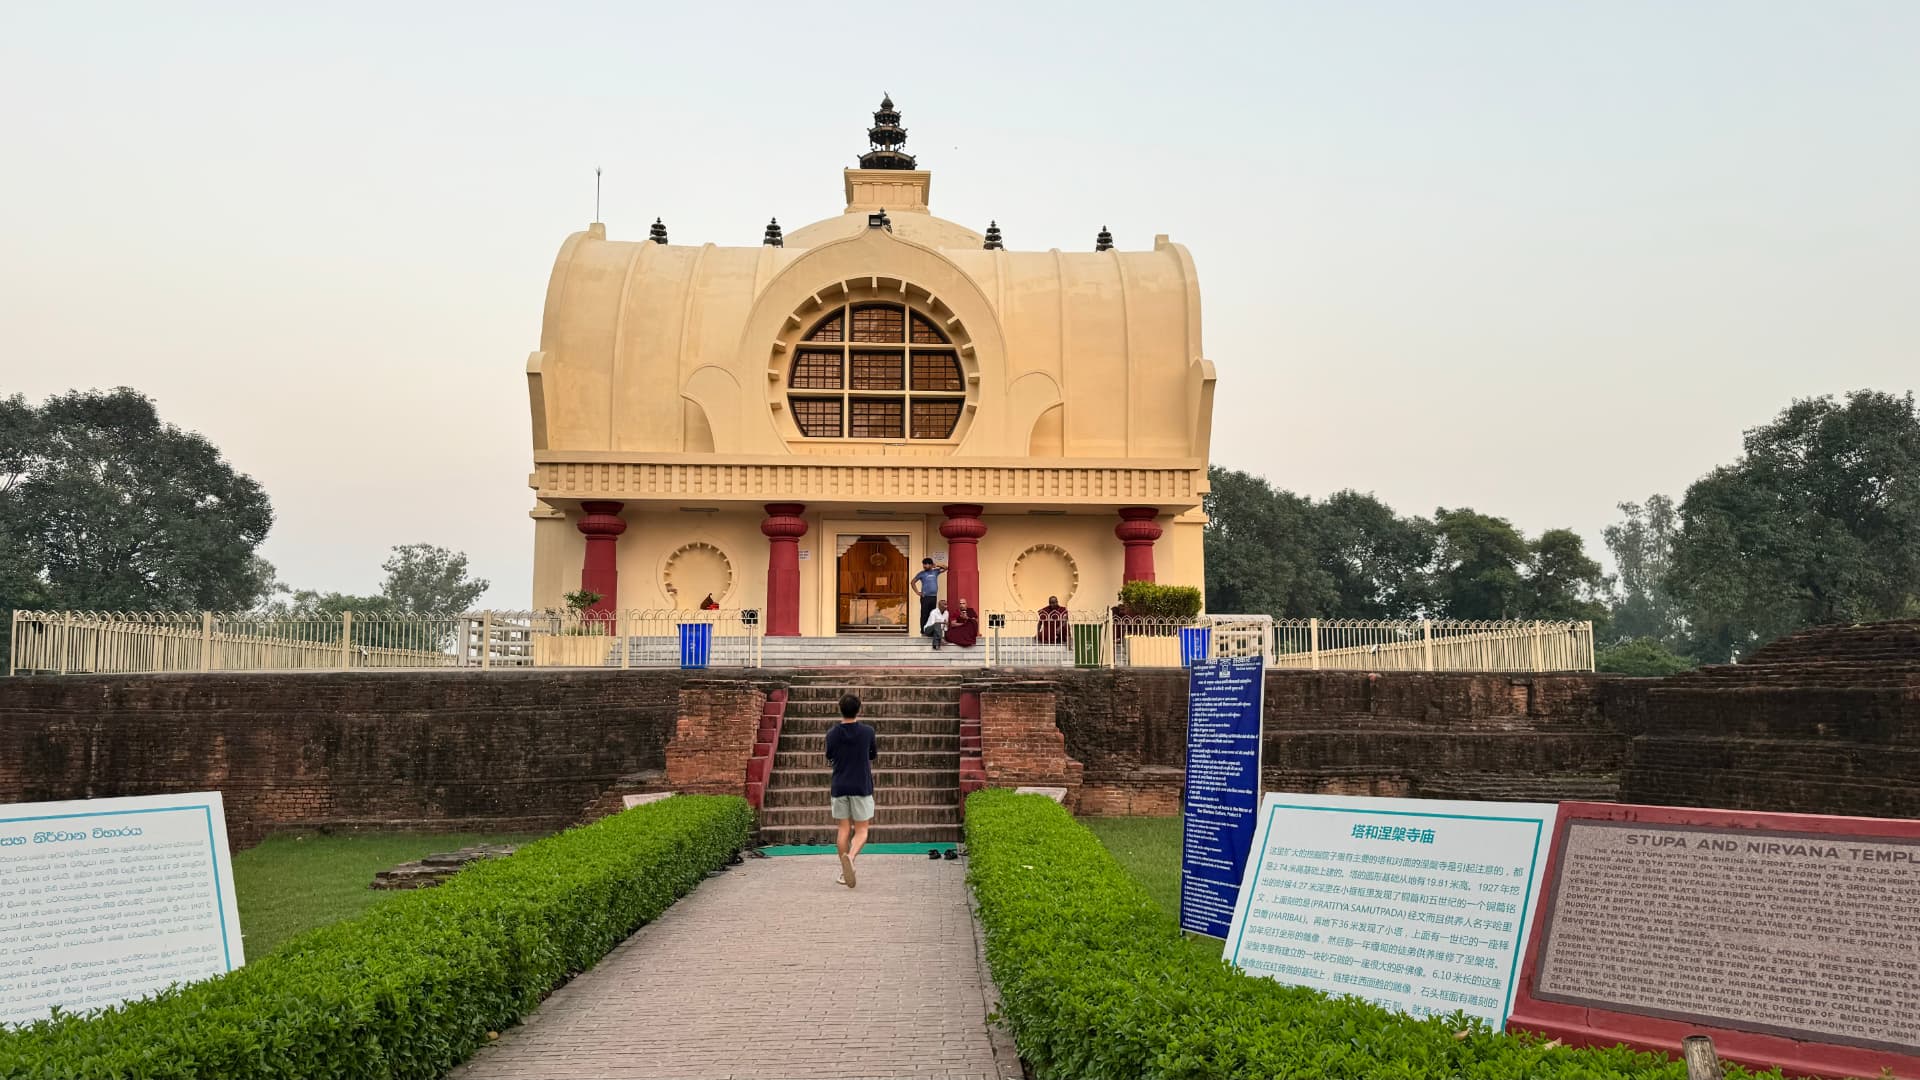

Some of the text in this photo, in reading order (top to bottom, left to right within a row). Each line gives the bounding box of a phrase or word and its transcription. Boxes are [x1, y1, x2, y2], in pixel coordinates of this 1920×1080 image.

[1350, 824, 1436, 844] 塔和涅槃寺庙
[1625, 833, 1687, 848] STUPA
[1696, 838, 1738, 851] AND
[1746, 841, 1839, 858] NIRVANA
[1610, 848, 1907, 876] MAIN FORM THE FOCUS OF
[1614, 856, 1634, 864] AND
[1767, 867, 1821, 878] PLATFORM
[1792, 878, 1819, 887] FROM
[1701, 904, 1746, 915] CIRCULAR
[1751, 908, 1787, 919] PLINTH
[1790, 912, 1802, 920] OF
[1816, 914, 1851, 925] SMALL
[1854, 918, 1888, 928] STUPA
[1735, 898, 1766, 908] GUPTA
[1836, 907, 1850, 916] OF
[1646, 924, 1674, 933] SAME
[1653, 916, 1673, 925] WAS
[1677, 919, 1739, 932] COMPLETELY
[1792, 930, 1813, 939] OUT
[1836, 934, 1856, 944] THE
[1860, 937, 1912, 949] DONATION
[1795, 921, 1807, 930] TO
[1811, 923, 1841, 933] FIRST
[1848, 926, 1895, 938] CENTURY
[1723, 941, 1772, 953] COLOSSAL
[1776, 946, 1840, 961] MONOLITHIC
[1845, 954, 1874, 964] SAND
[1881, 958, 1917, 969] STONE
[1771, 955, 1808, 966] STATUE
[1818, 960, 1853, 972] RESTS
[1883, 967, 1914, 979] BRICK
[1705, 956, 1750, 969] WESTERN
[1753, 962, 1776, 972] FACE
[1780, 965, 1793, 974] OF
[1821, 970, 1875, 984] PEDESTAL
[1879, 977, 1899, 987] HAS
[1750, 971, 1764, 980] AN
[1768, 973, 1832, 988] INSCRIPTION
[1837, 981, 1852, 991] OF
[1857, 984, 1891, 995] FIFTH
[1657, 969, 1675, 978] THE
[1679, 971, 1708, 982] IMAGE
[1711, 975, 1724, 984] BY
[1810, 988, 1828, 997] THE
[1831, 990, 1869, 1003] STATUE
[1873, 995, 1892, 1006] AND
[1896, 998, 1916, 1009] THE
[1714, 985, 1742, 996] LATER
[1745, 989, 1759, 998] ON
[1762, 991, 1811, 1005] RESTORED
[1814, 998, 1827, 1007] BY
[1665, 988, 1692, 998] GIVEN
[1694, 992, 1704, 1000] IN
[1771, 1002, 1816, 1015] OCCASION
[1820, 1008, 1835, 1018] OF
[1753, 1009, 1805, 1024] COMMITTEE
[1808, 1017, 1864, 1032] APPOINTED
[1868, 1025, 1882, 1035] BY
[1887, 1027, 1916, 1039] UNION
